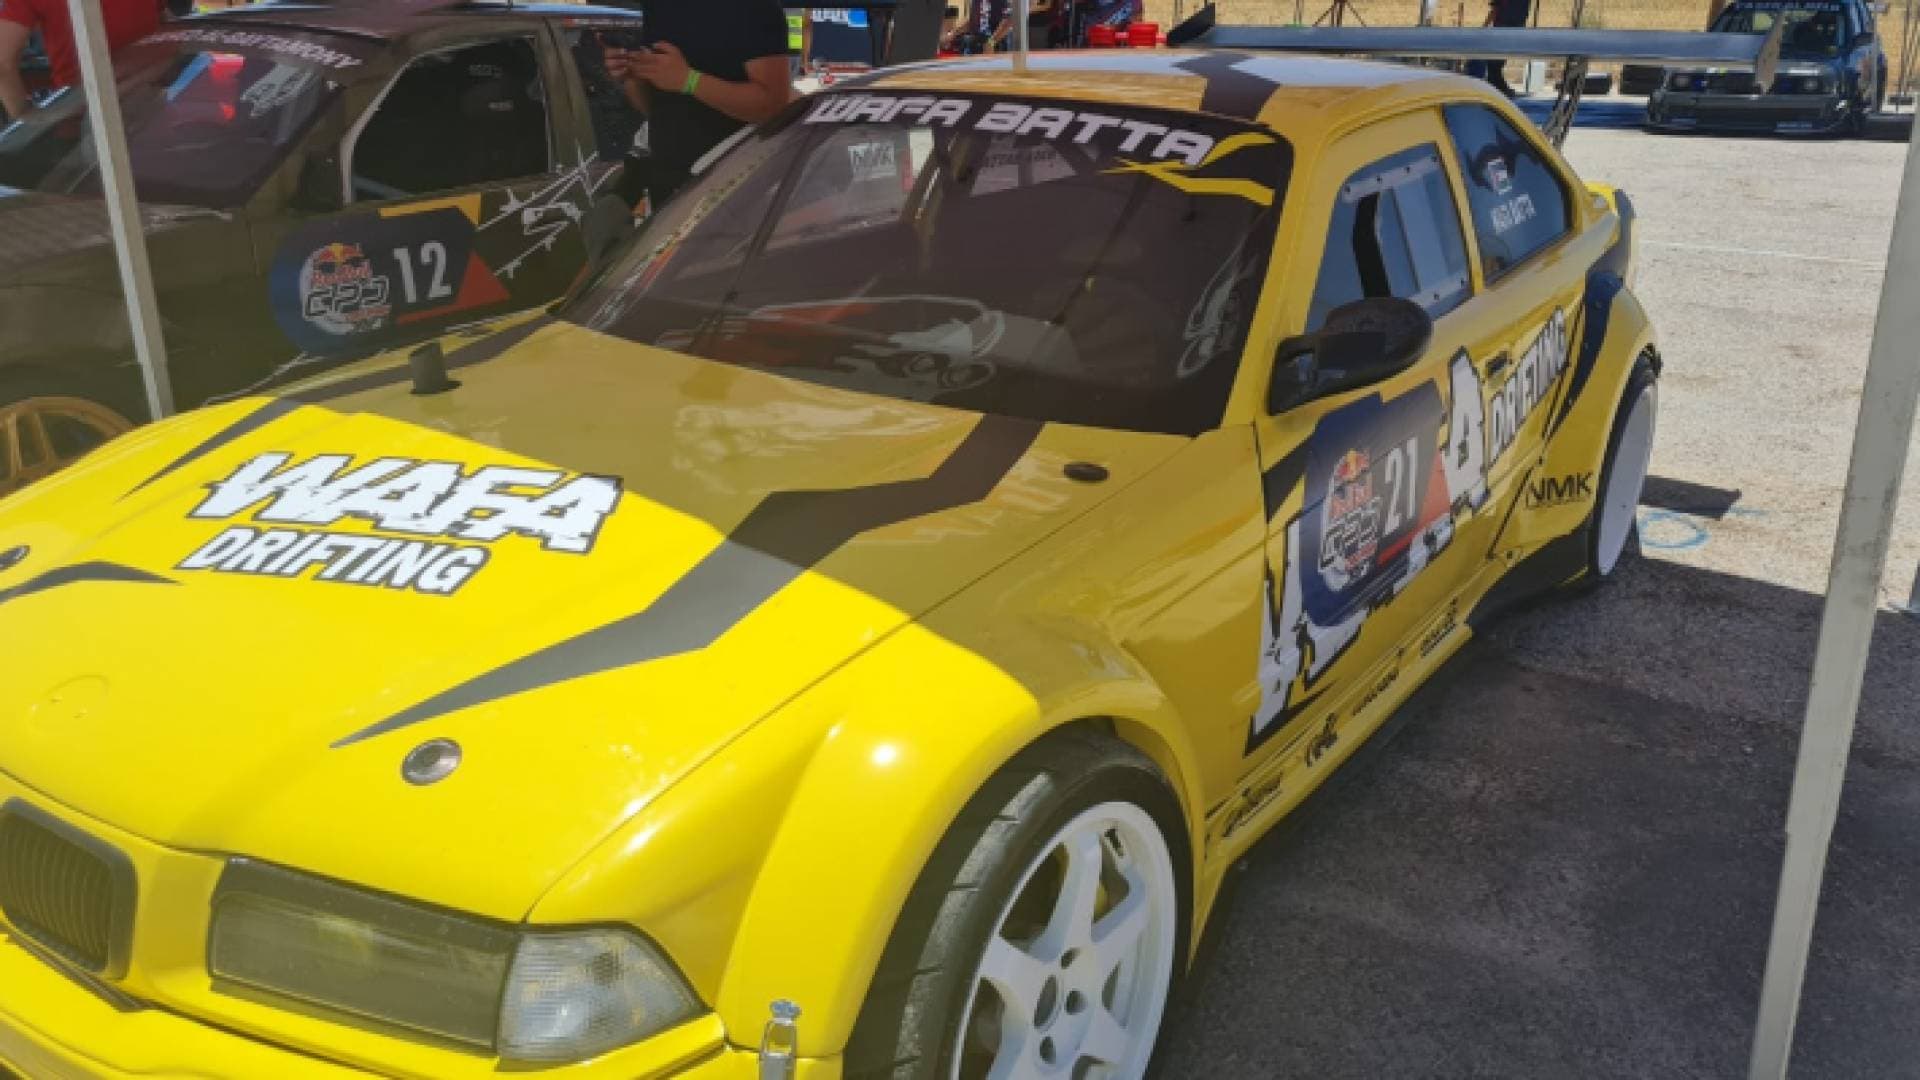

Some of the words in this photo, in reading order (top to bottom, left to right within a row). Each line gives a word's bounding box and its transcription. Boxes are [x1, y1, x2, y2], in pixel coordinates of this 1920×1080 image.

[804, 94, 973, 127] WAFA
[973, 103, 1216, 166] BATTA
[393, 242, 453, 304] 12
[1488, 305, 1571, 470] DRIFTING
[185, 451, 623, 554] WAFA
[1384, 436, 1420, 538] 21
[1526, 472, 1593, 506] NMK
[173, 526, 492, 597] DRIFTING
